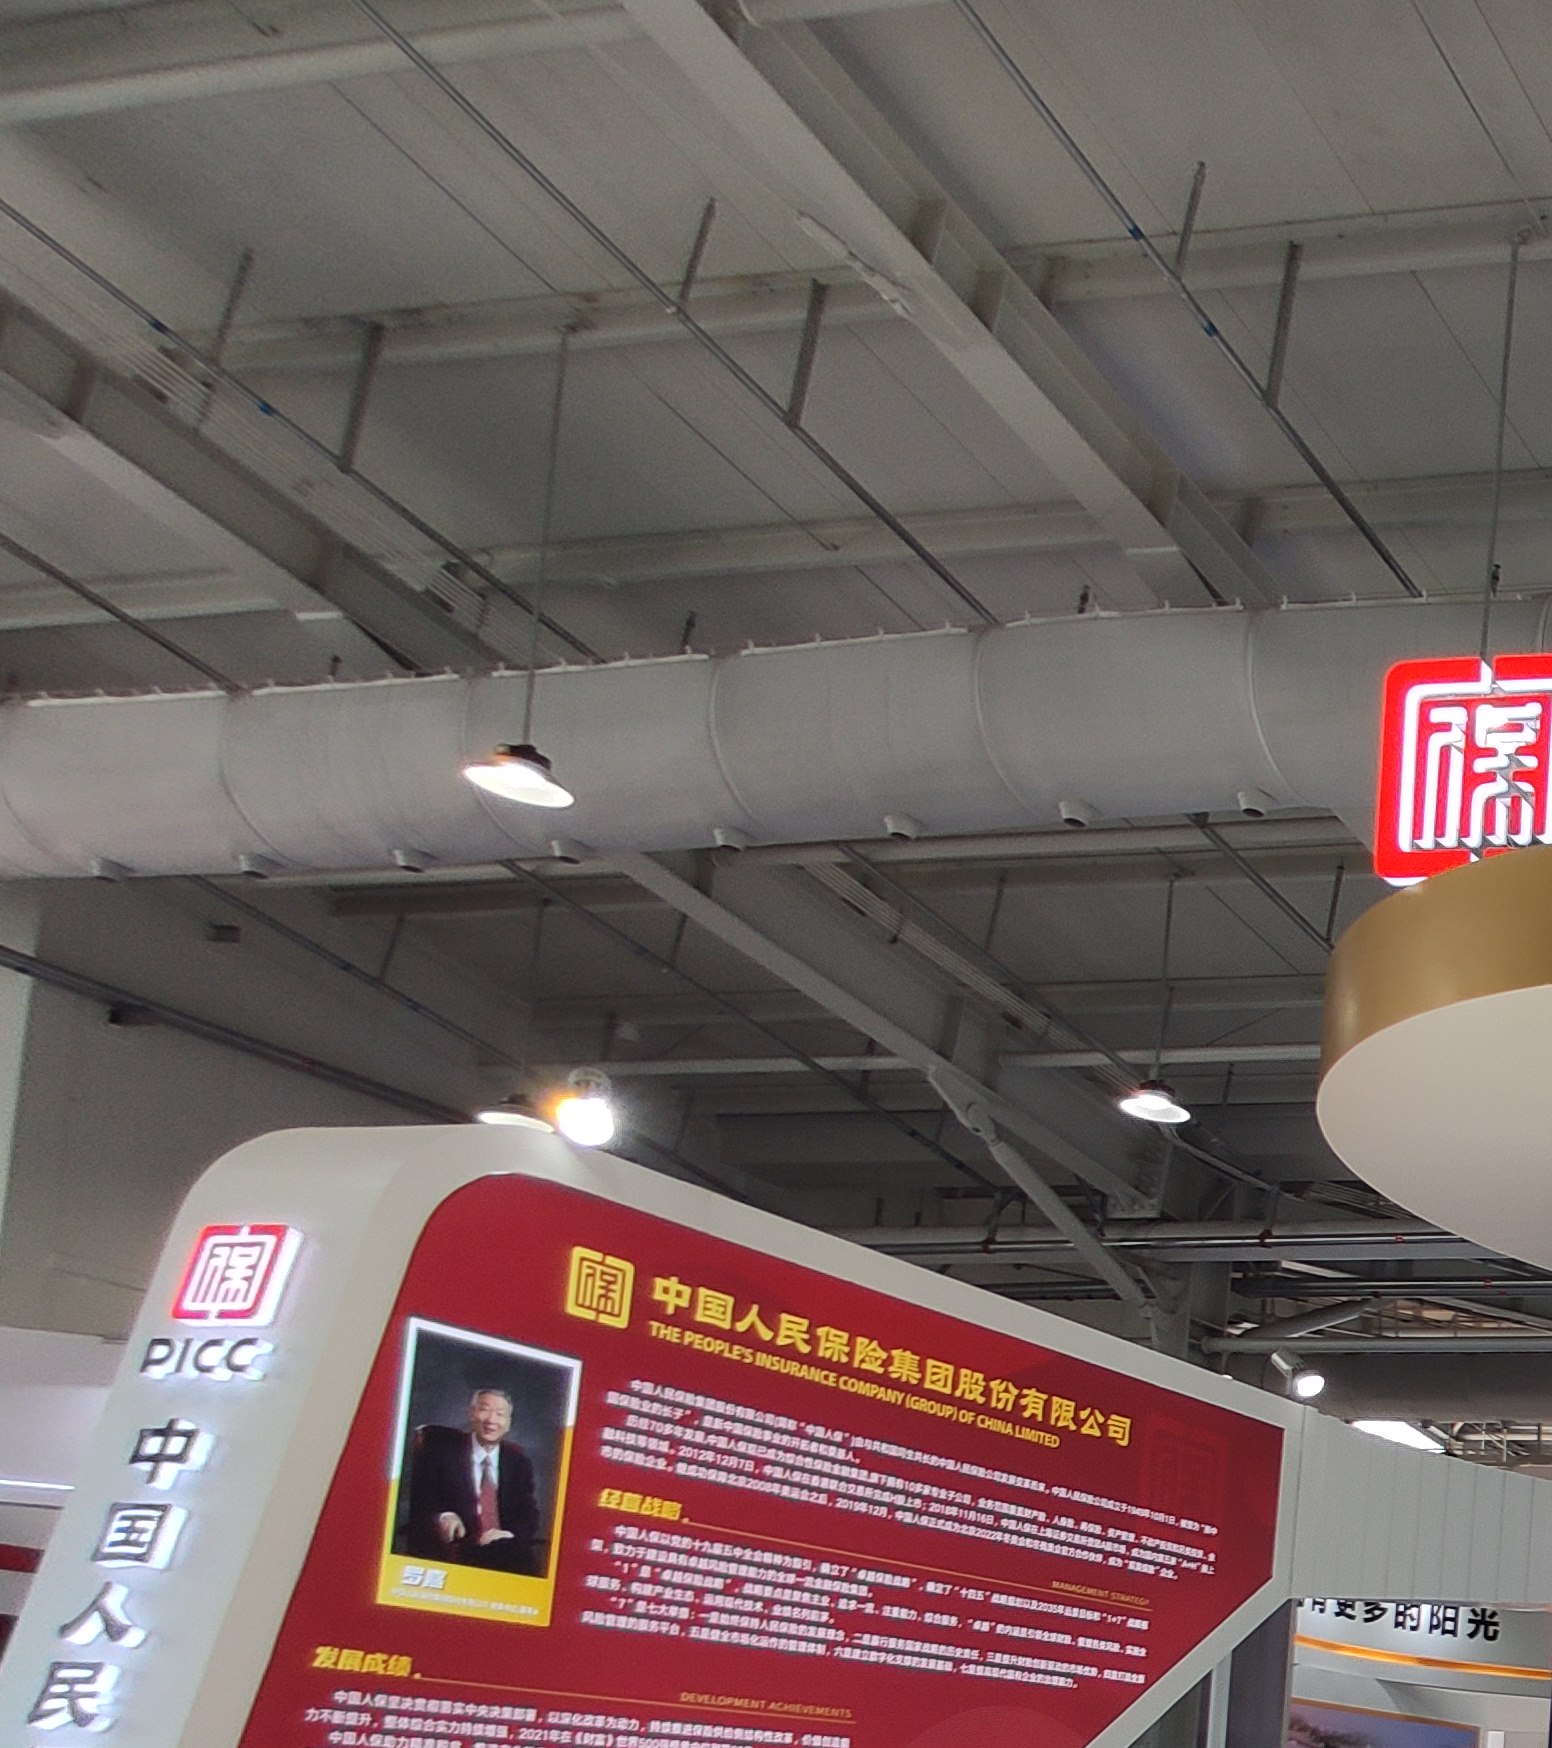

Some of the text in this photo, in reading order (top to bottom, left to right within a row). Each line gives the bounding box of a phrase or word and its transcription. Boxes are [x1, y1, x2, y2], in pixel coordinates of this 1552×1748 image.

[141, 1337, 268, 1379] PICC
[649, 1320, 1061, 1449] THE PEOPLE'S INSURANCE COMPANY (GROUP) OF CHINA LIMITED
[650, 1274, 1133, 1447] 中国人民保险集团股份有限公司
[680, 1691, 853, 1719] DEVELOPMENT ACHIEVEMENTS
